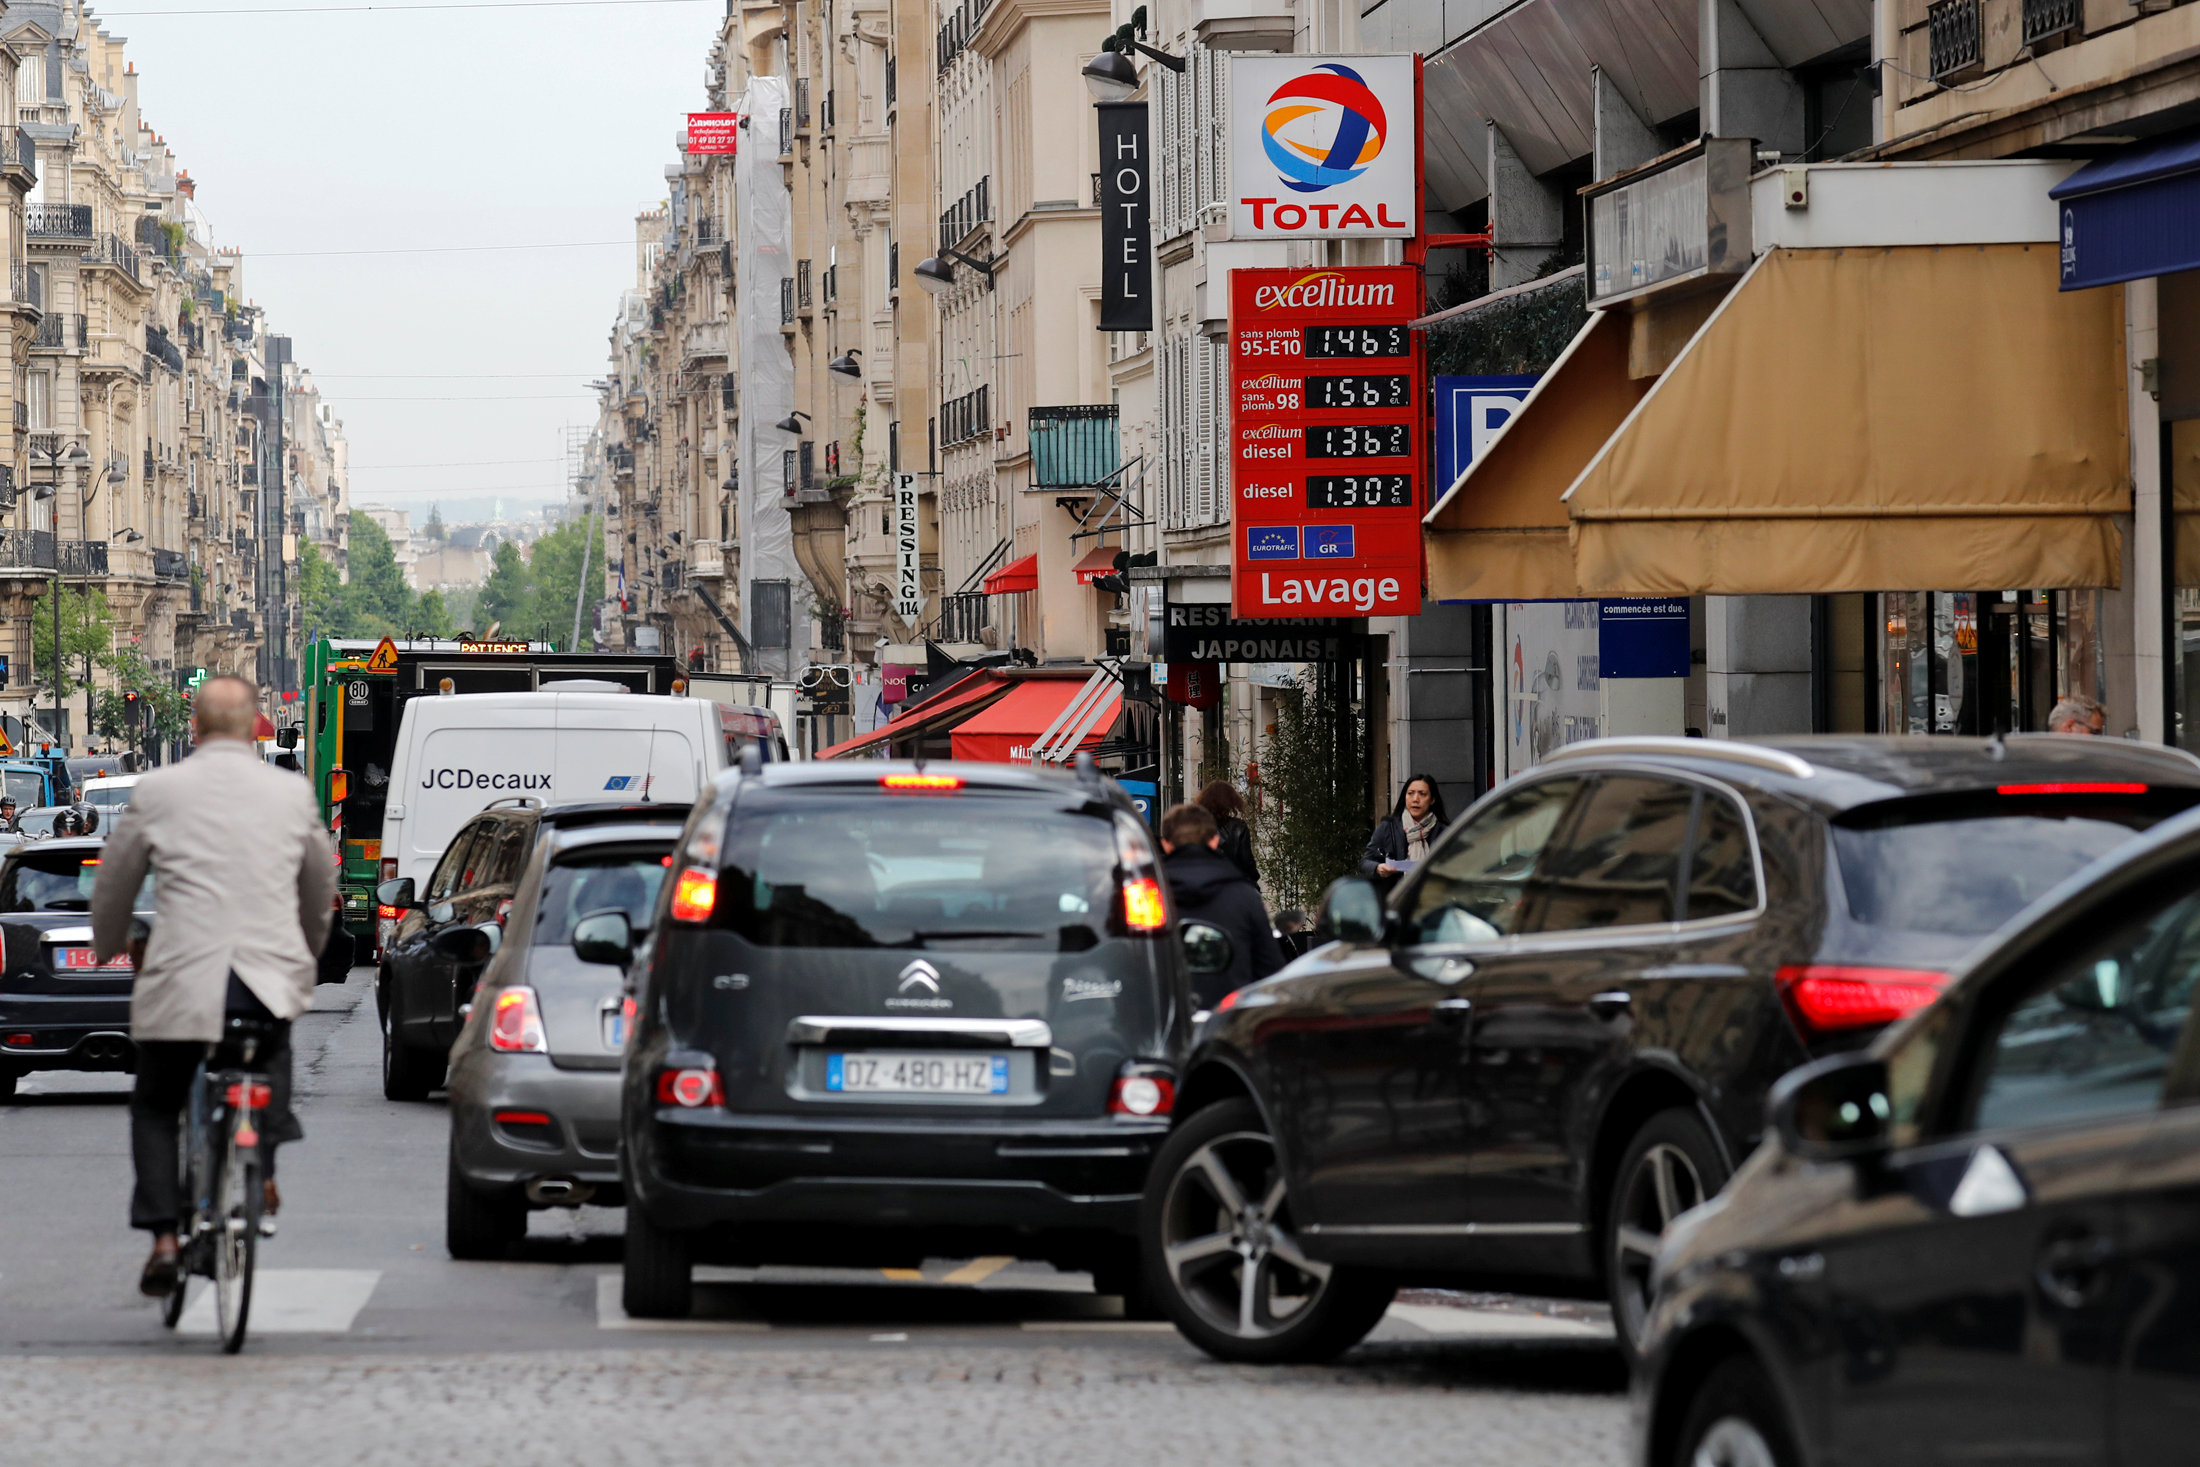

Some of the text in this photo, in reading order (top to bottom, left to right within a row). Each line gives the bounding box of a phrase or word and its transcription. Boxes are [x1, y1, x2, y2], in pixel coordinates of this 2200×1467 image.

[1117, 134, 1140, 298] HOTEL
[1241, 198, 1406, 230] TOTAL
[1255, 277, 1394, 308] excellium
[1240, 328, 1300, 341] sans plomb
[1241, 340, 1301, 356] 95-E10
[1241, 376, 1302, 390] excellium
[1242, 393, 1265, 401] sans
[1242, 393, 1299, 412] plomb 98
[1242, 425, 1302, 440] excellium
[1242, 443, 1292, 459] diesel
[1243, 483, 1293, 499] diesel
[900, 475, 916, 598] PRESSING
[1252, 544, 1295, 552] EUROTRAFIC
[1319, 544, 1338, 553] GR
[1261, 572, 1400, 611] Lavage
[899, 602, 919, 616] 114
[1603, 603, 1685, 613] commencée est due.
[461, 643, 527, 653] PATIENCE
[1191, 639, 1321, 659] JAPONAIS
[352, 682, 366, 697] 80
[422, 768, 552, 789] JCDecaux
